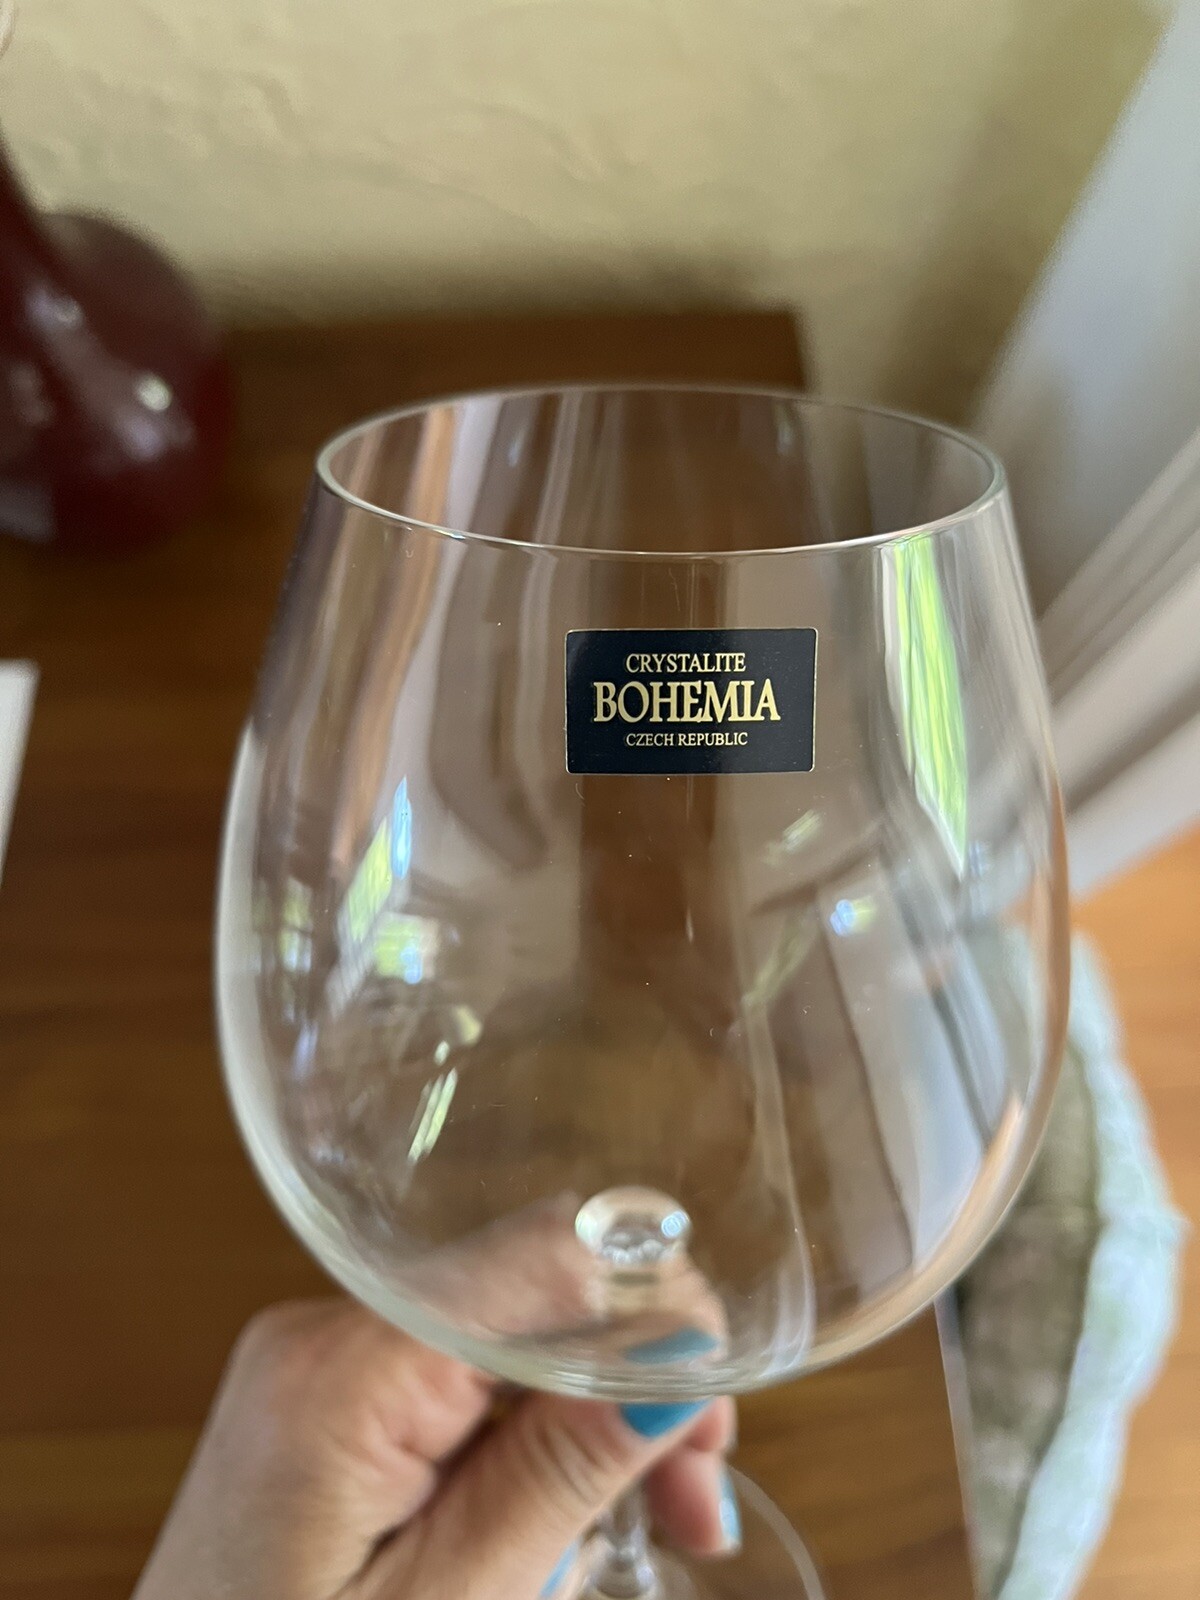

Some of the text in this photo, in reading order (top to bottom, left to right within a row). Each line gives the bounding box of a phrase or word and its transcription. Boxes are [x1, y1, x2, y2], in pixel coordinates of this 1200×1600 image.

[625, 652, 747, 673] CRYSTALITE
[593, 678, 782, 723] BOHEMIA
[625, 732, 749, 747] CZECH REPUBLIC
